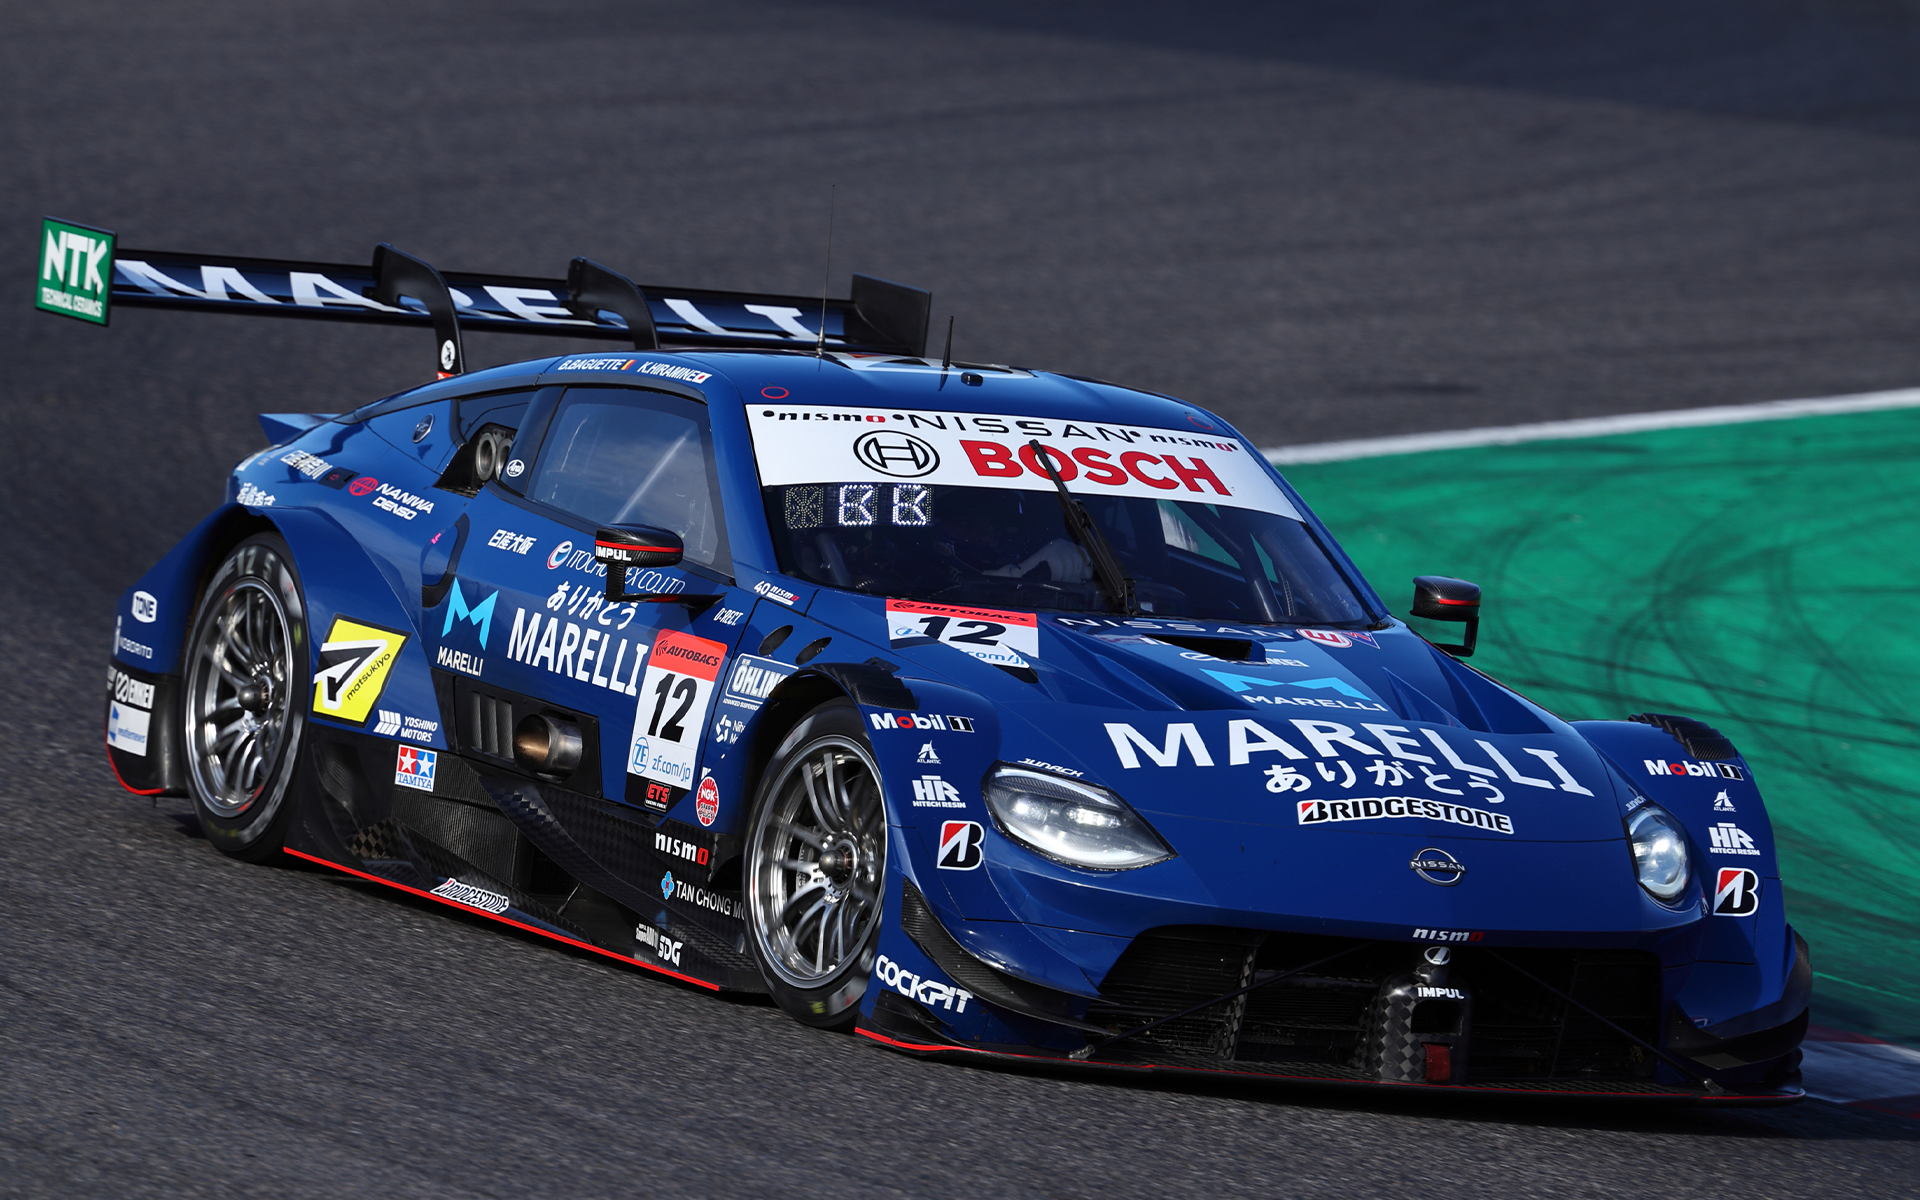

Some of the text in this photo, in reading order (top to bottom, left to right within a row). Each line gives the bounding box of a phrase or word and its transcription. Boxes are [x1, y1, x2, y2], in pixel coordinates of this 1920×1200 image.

[42, 228, 108, 295] NTK
[557, 358, 699, 383] B.BAGUETTE K.HIRAMINE
[778, 411, 1234, 453] nismo NISSAN nismo
[958, 439, 1233, 497] BOSCH
[371, 495, 418, 521] DENSO
[375, 482, 435, 514] NANIWA
[487, 528, 537, 556] 日産大阪
[595, 545, 632, 562] IMPUL
[753, 580, 801, 602] 40 nismo
[135, 595, 154, 619] TONE
[546, 580, 639, 631] ありがとう
[915, 603, 1030, 622] AUTOBACS
[918, 616, 1007, 647] 12
[1056, 616, 1295, 640] NISSAN
[436, 645, 484, 677] MARELLI
[506, 606, 650, 697] MARELLI
[666, 644, 720, 667] AUTOBACS
[346, 652, 392, 701] matsukiyo
[647, 672, 698, 744] 12
[1240, 694, 1389, 712] MARELLI
[404, 715, 438, 732] YOSHINO
[869, 712, 947, 731] Mobil
[400, 727, 433, 743] MOTORS
[651, 754, 692, 783] zf.com/jp
[1102, 718, 1596, 798] MARELLI
[1643, 759, 1718, 778] Mobil
[396, 772, 433, 789] TAMIYA
[646, 782, 670, 804] ETS
[1263, 758, 1506, 804] ありがとう
[700, 788, 717, 803] NGK
[912, 800, 967, 809] HITECH RESIN
[1299, 796, 1514, 835] BRIDGESTONE
[654, 832, 709, 866] nismo
[1709, 846, 1761, 856] HITECH RESIN
[1409, 859, 1467, 873] NISSAN
[430, 877, 510, 915] BRIDGESTONE
[676, 880, 696, 904] TAN
[695, 887, 731, 916] CHONG
[1412, 927, 1485, 942] nismo
[874, 953, 974, 1014] COCKPIT
[1417, 986, 1465, 1000] IMPUL
